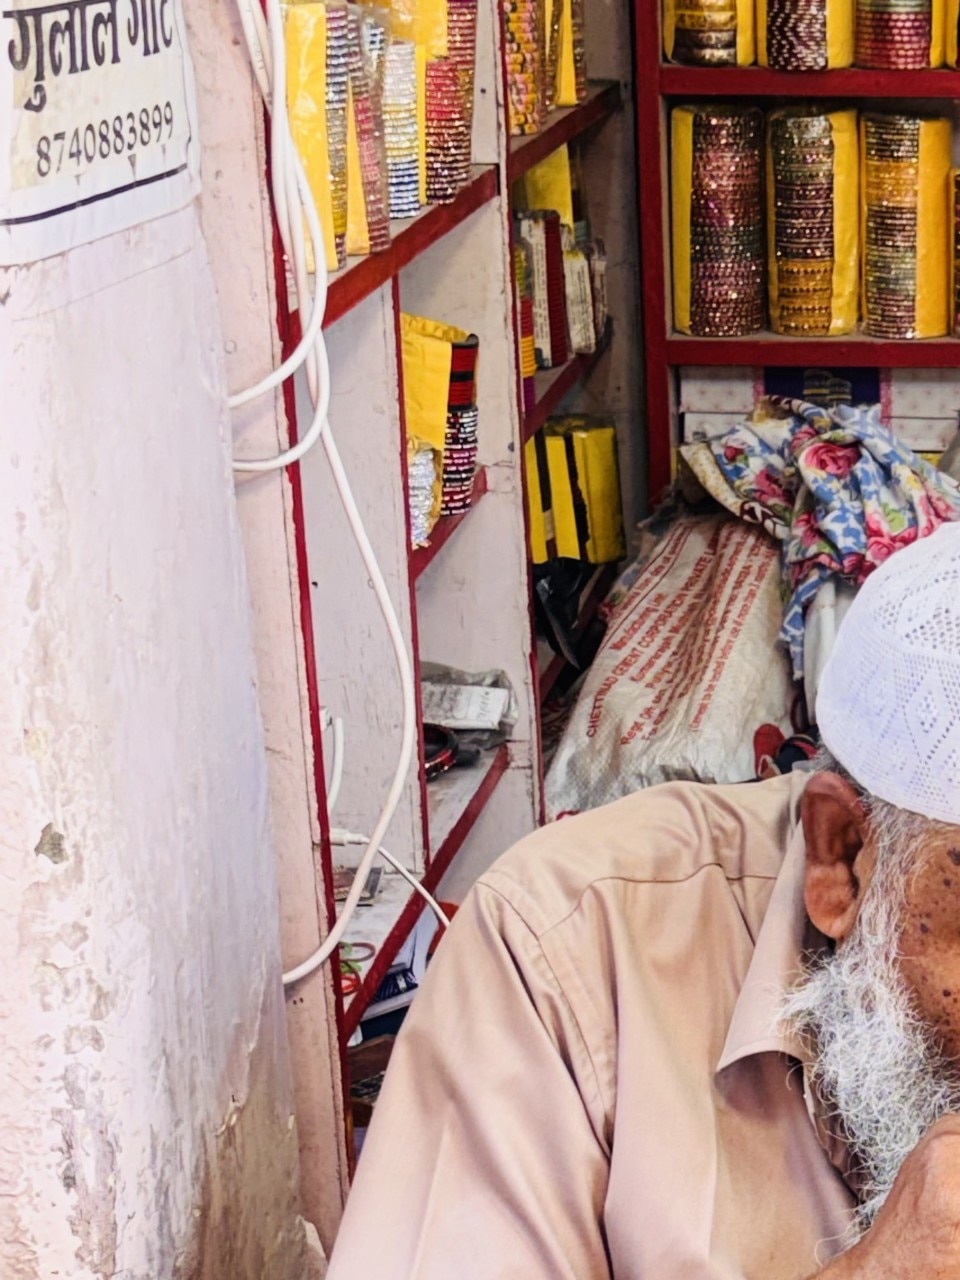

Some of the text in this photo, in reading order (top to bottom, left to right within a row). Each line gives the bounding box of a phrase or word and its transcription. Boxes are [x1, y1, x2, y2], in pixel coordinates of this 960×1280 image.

[36, 101, 174, 178] 8740883899
[585, 677, 618, 737] CHETTINAD
[611, 648, 644, 674] CEMENT
[636, 593, 689, 647] CORPORATION
[680, 556, 712, 591] PRIVATE
